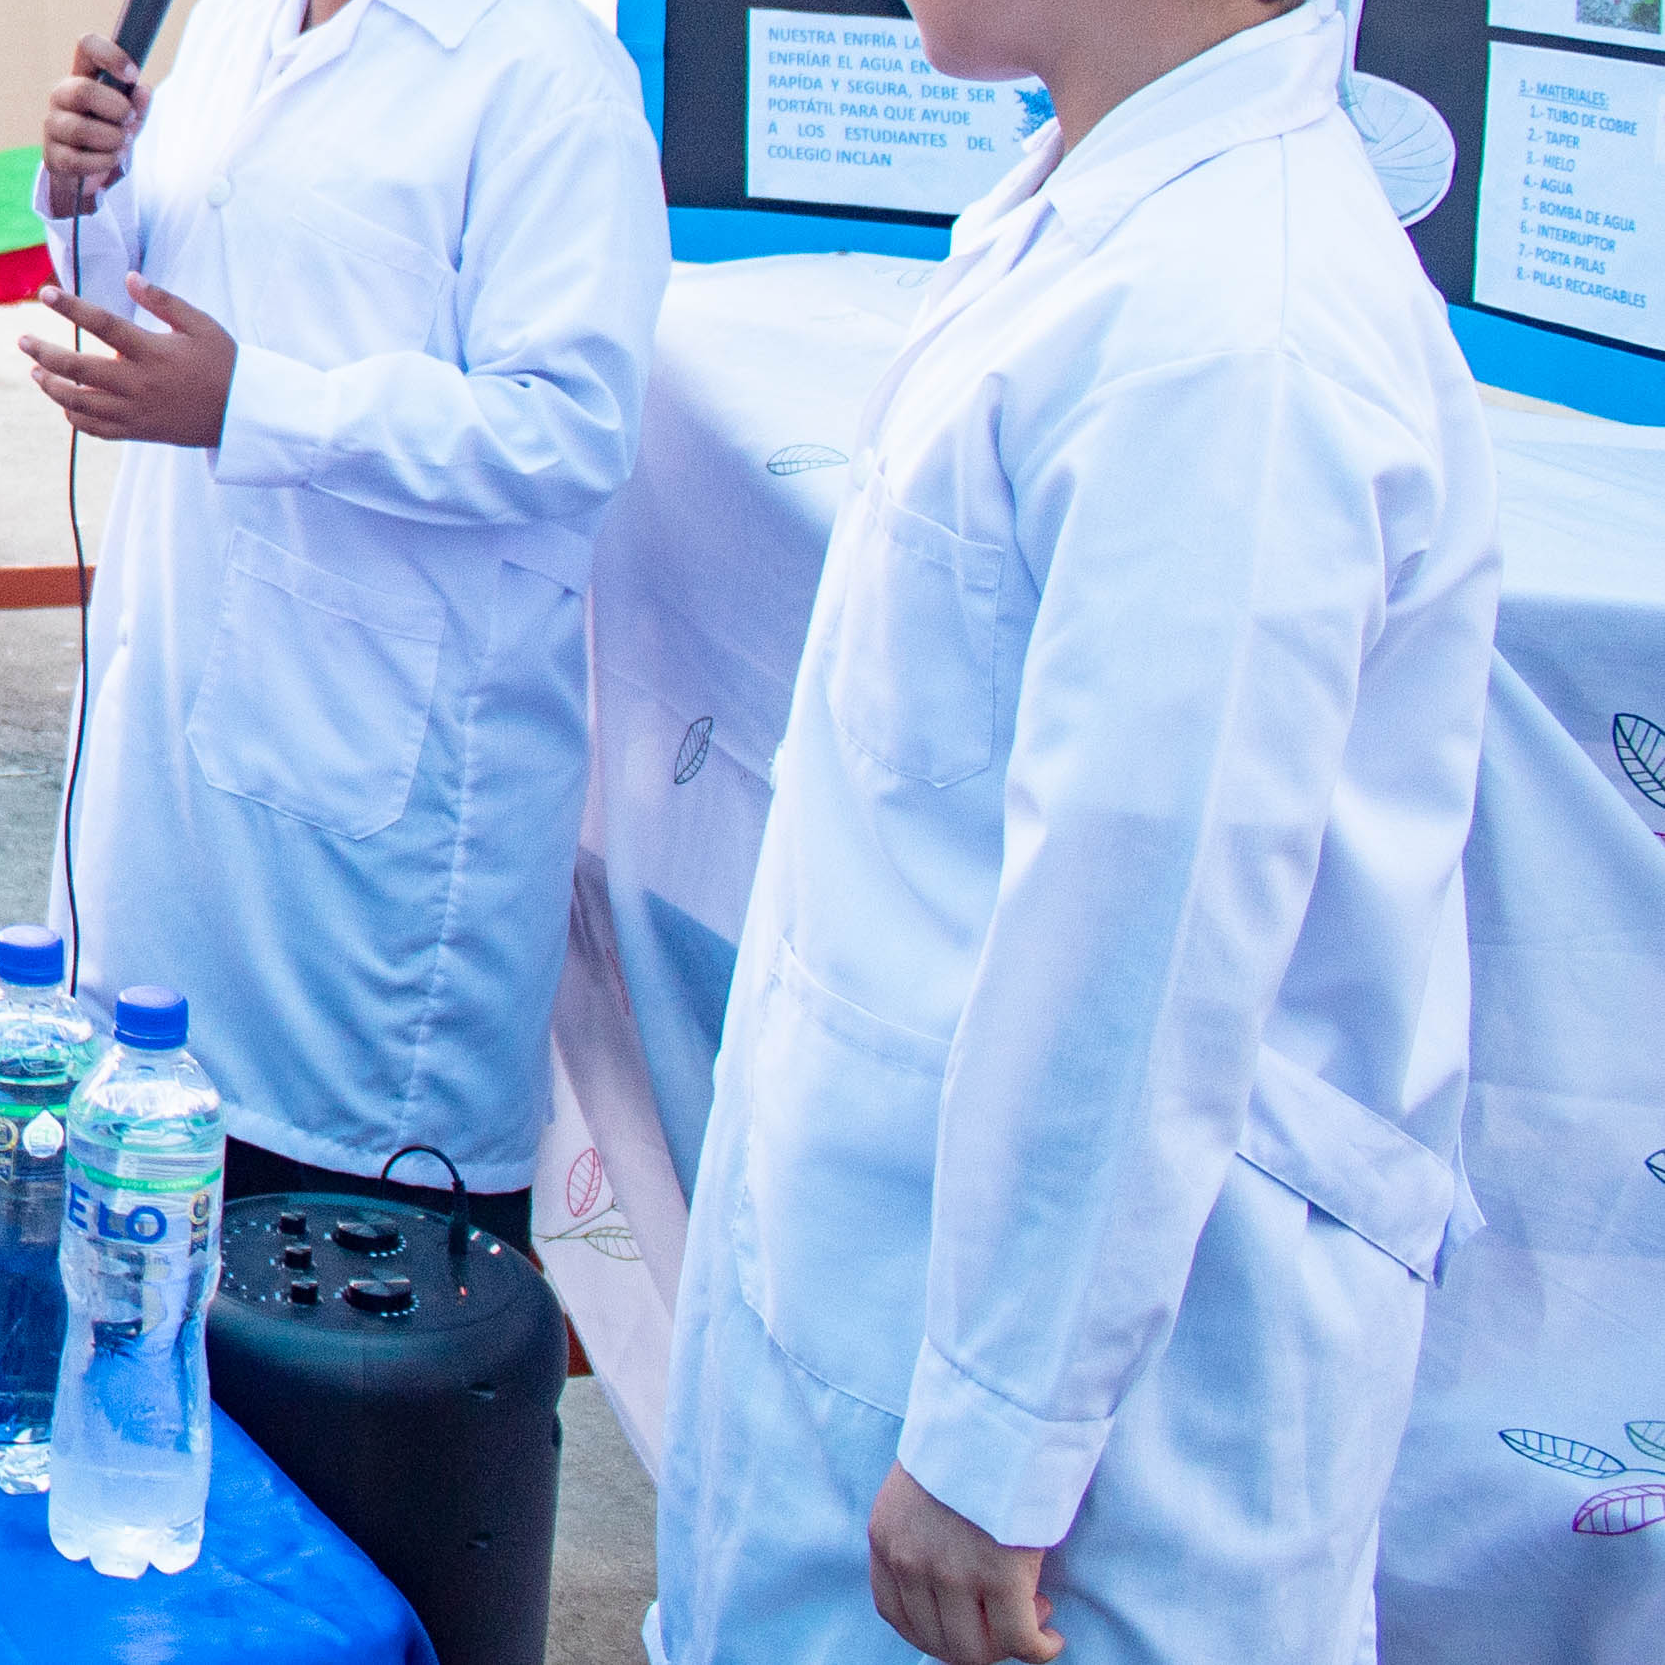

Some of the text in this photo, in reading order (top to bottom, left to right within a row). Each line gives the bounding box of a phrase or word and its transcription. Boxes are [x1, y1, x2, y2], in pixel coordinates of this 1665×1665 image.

[769, 28, 921, 50] NUESTRA ENFRÍA LA
[769, 51, 831, 67] ENFRÍAR
[838, 55, 852, 69] EL
[860, 57, 902, 72] AGUA
[769, 74, 995, 102] RAPÍDA Y SEGURA, DEBE SER
[769, 98, 971, 126] PORTÁTIL PARA QUE AYUDE
[1547, 108, 1578, 125] TUBO
[1582, 114, 1596, 128] DE
[1599, 117, 1637, 135] COBRE
[798, 124, 825, 137] LOS
[846, 126, 947, 148] ESTUDIANTES
[968, 136, 995, 152] DEL
[1546, 131, 1580, 148] TAPER
[769, 145, 831, 162] COLEGIO
[1543, 154, 1576, 172] HIELO
[1540, 177, 1573, 194] AGUA
[1539, 201, 1582, 221] BOMBA
[1586, 207, 1601, 224] DE
[1605, 212, 1636, 232] AGUA
[1537, 224, 1615, 253] INTERRUPTOR
[1536, 247, 1569, 266] PORTA
[1574, 256, 1605, 274] PILAS
[1533, 270, 1562, 289] PILAS
[1566, 277, 1646, 308] RECARGABLES
